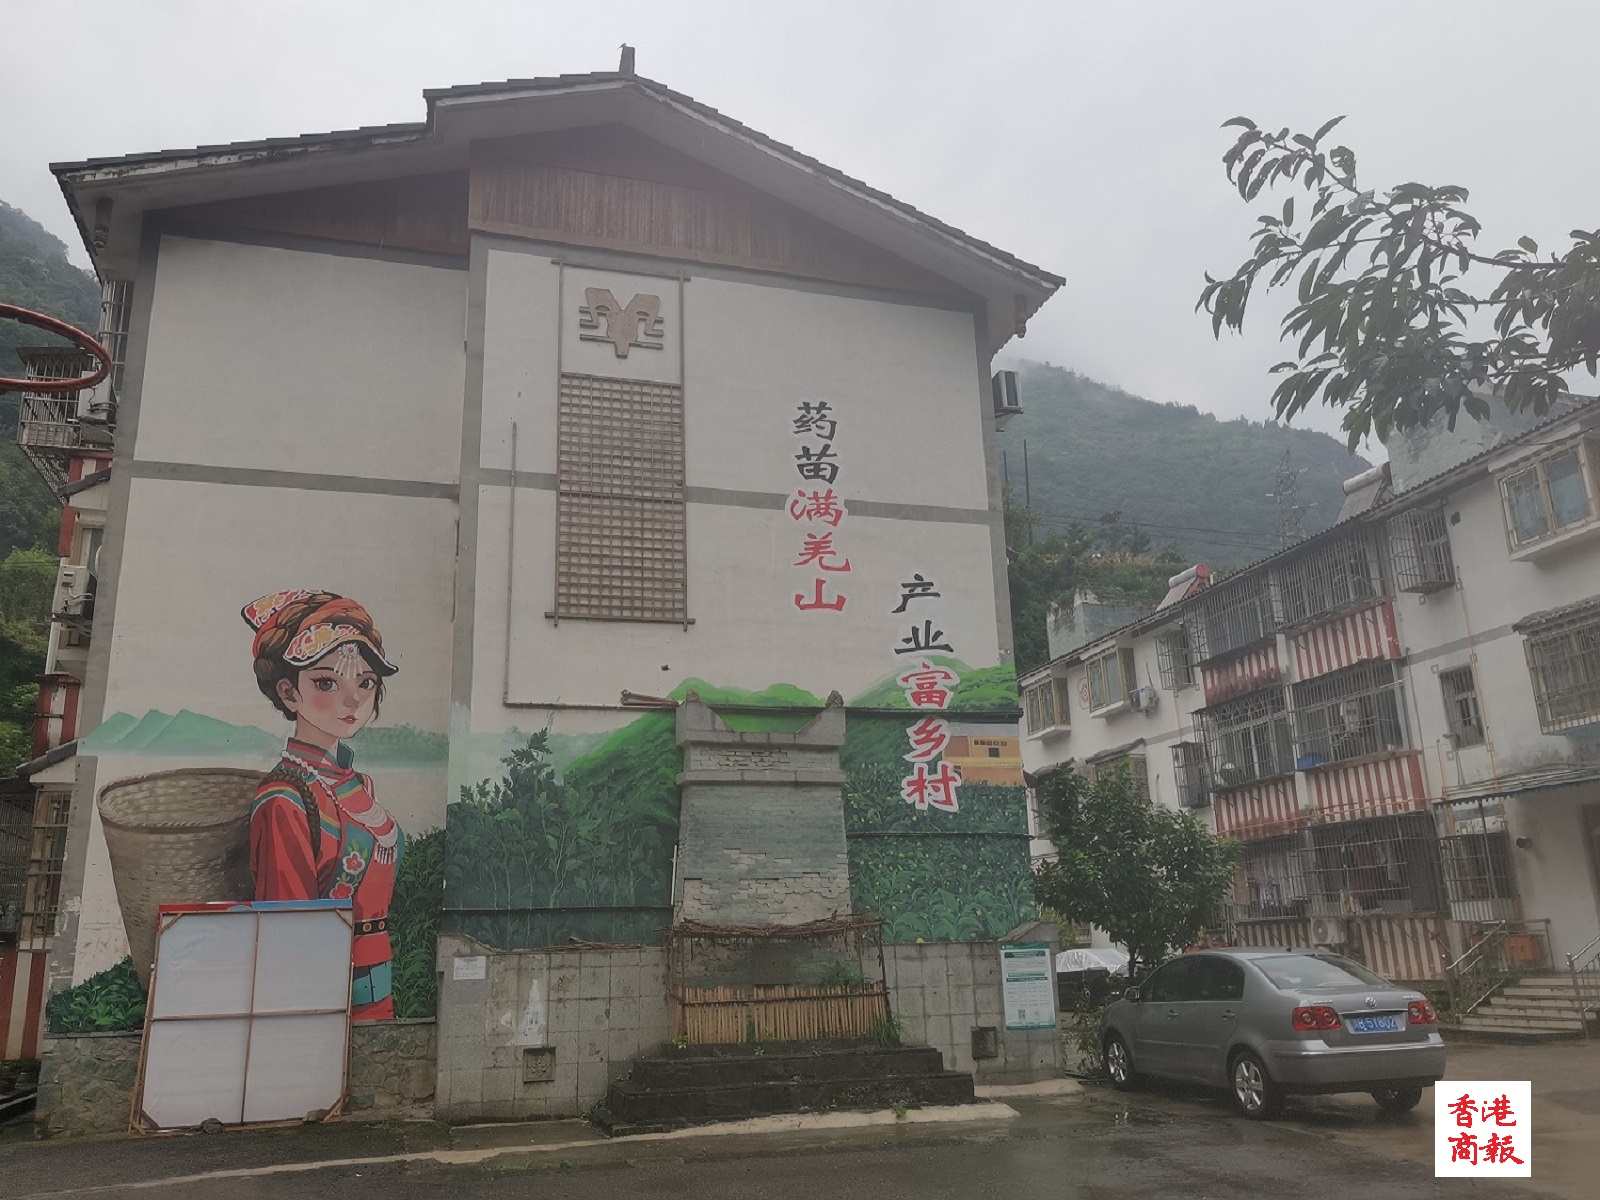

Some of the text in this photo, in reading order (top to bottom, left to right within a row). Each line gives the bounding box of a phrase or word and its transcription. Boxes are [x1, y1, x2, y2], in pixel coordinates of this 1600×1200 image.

[790, 401, 851, 612] 药苗满羌山
[891, 573, 958, 806] 产业富乡村
